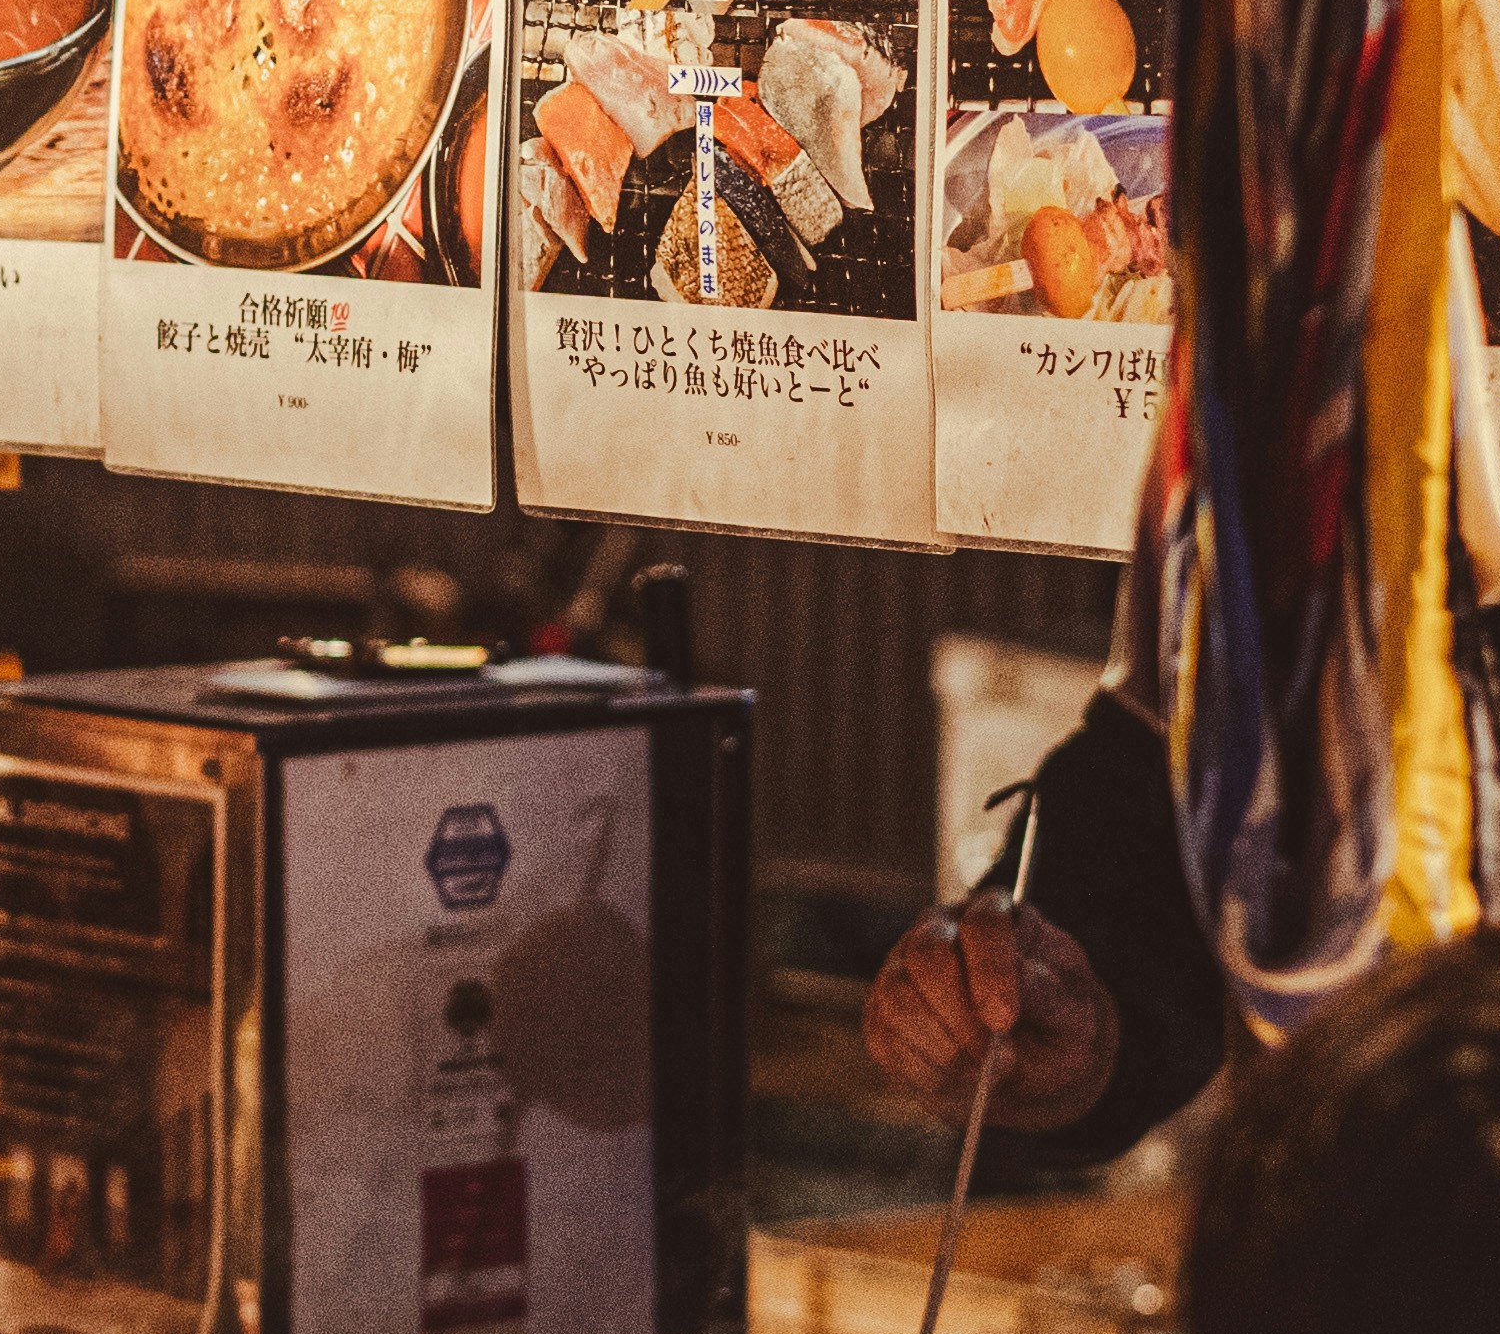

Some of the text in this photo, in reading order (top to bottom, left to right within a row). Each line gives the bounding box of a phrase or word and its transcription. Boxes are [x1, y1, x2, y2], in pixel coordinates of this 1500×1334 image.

[698, 104, 715, 295] 骨なしそのまま
[239, 292, 329, 331] 合格祈願
[157, 319, 270, 360] 餃子と焼売
